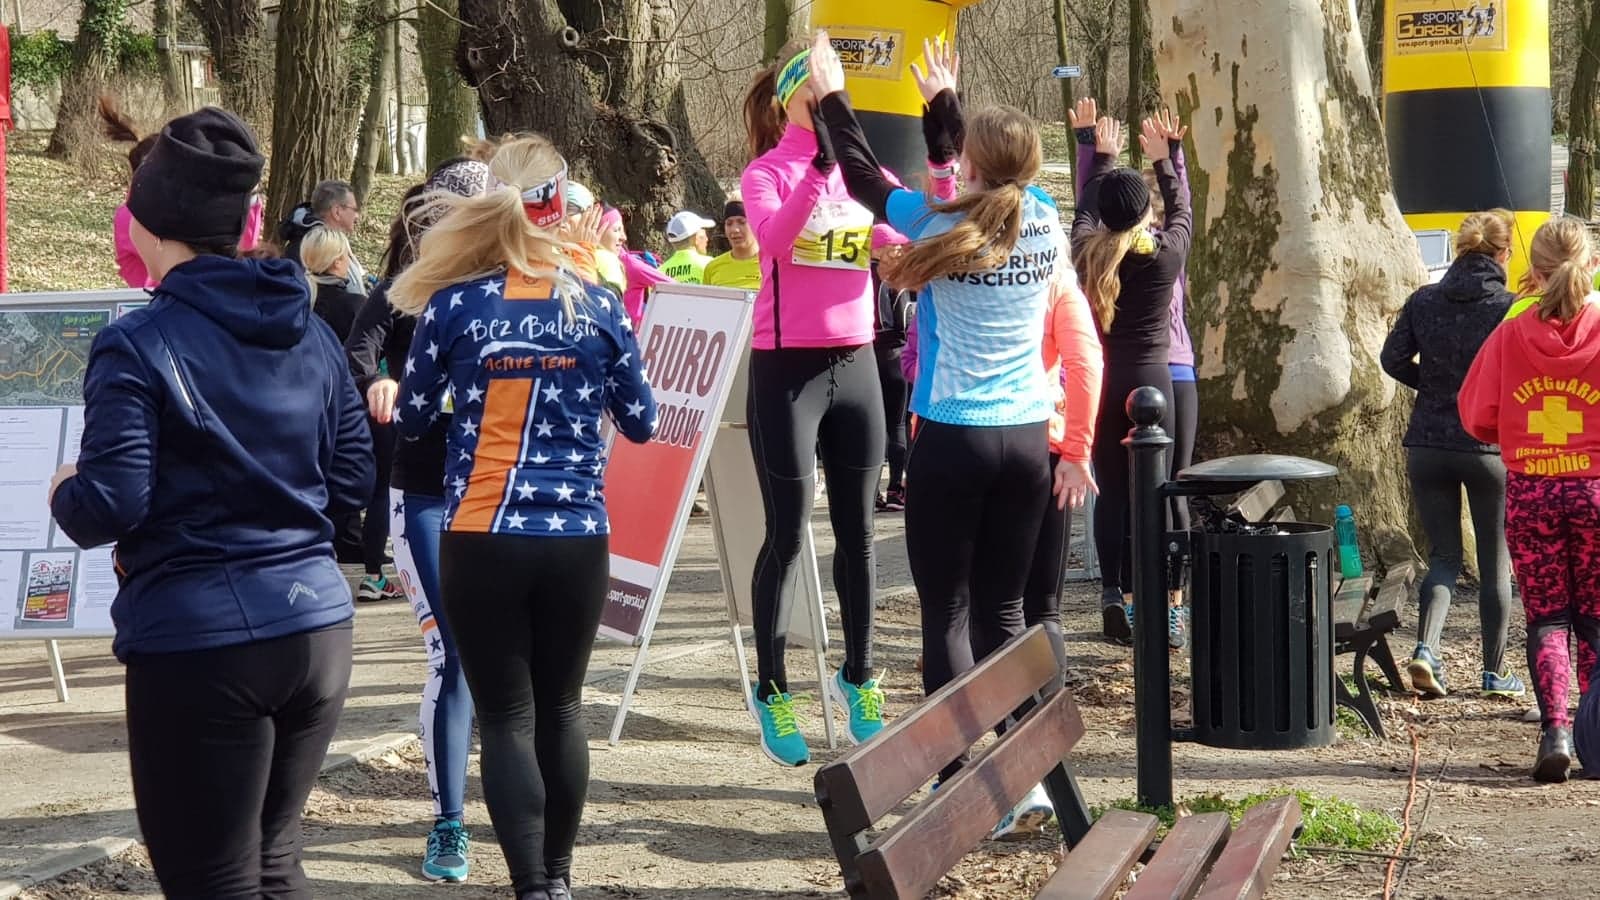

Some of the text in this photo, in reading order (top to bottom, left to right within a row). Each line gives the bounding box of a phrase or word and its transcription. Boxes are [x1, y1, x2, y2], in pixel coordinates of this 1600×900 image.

[1422, 12, 1462, 24] SPORT
[831, 39, 865, 50] SPORT
[840, 50, 864, 62] SKI
[1019, 222, 1051, 238] ulka
[820, 229, 859, 263] 15
[665, 264, 691, 278] ADAM
[947, 264, 1053, 287] WSCHOWA
[464, 318, 513, 342] Bez
[484, 355, 577, 371] ACTIVE TEAM
[643, 324, 727, 398] BIURO
[1512, 376, 1600, 405] LIFEGUARD
[651, 399, 705, 448] ODÓW
[1524, 452, 1591, 476] Sophie
